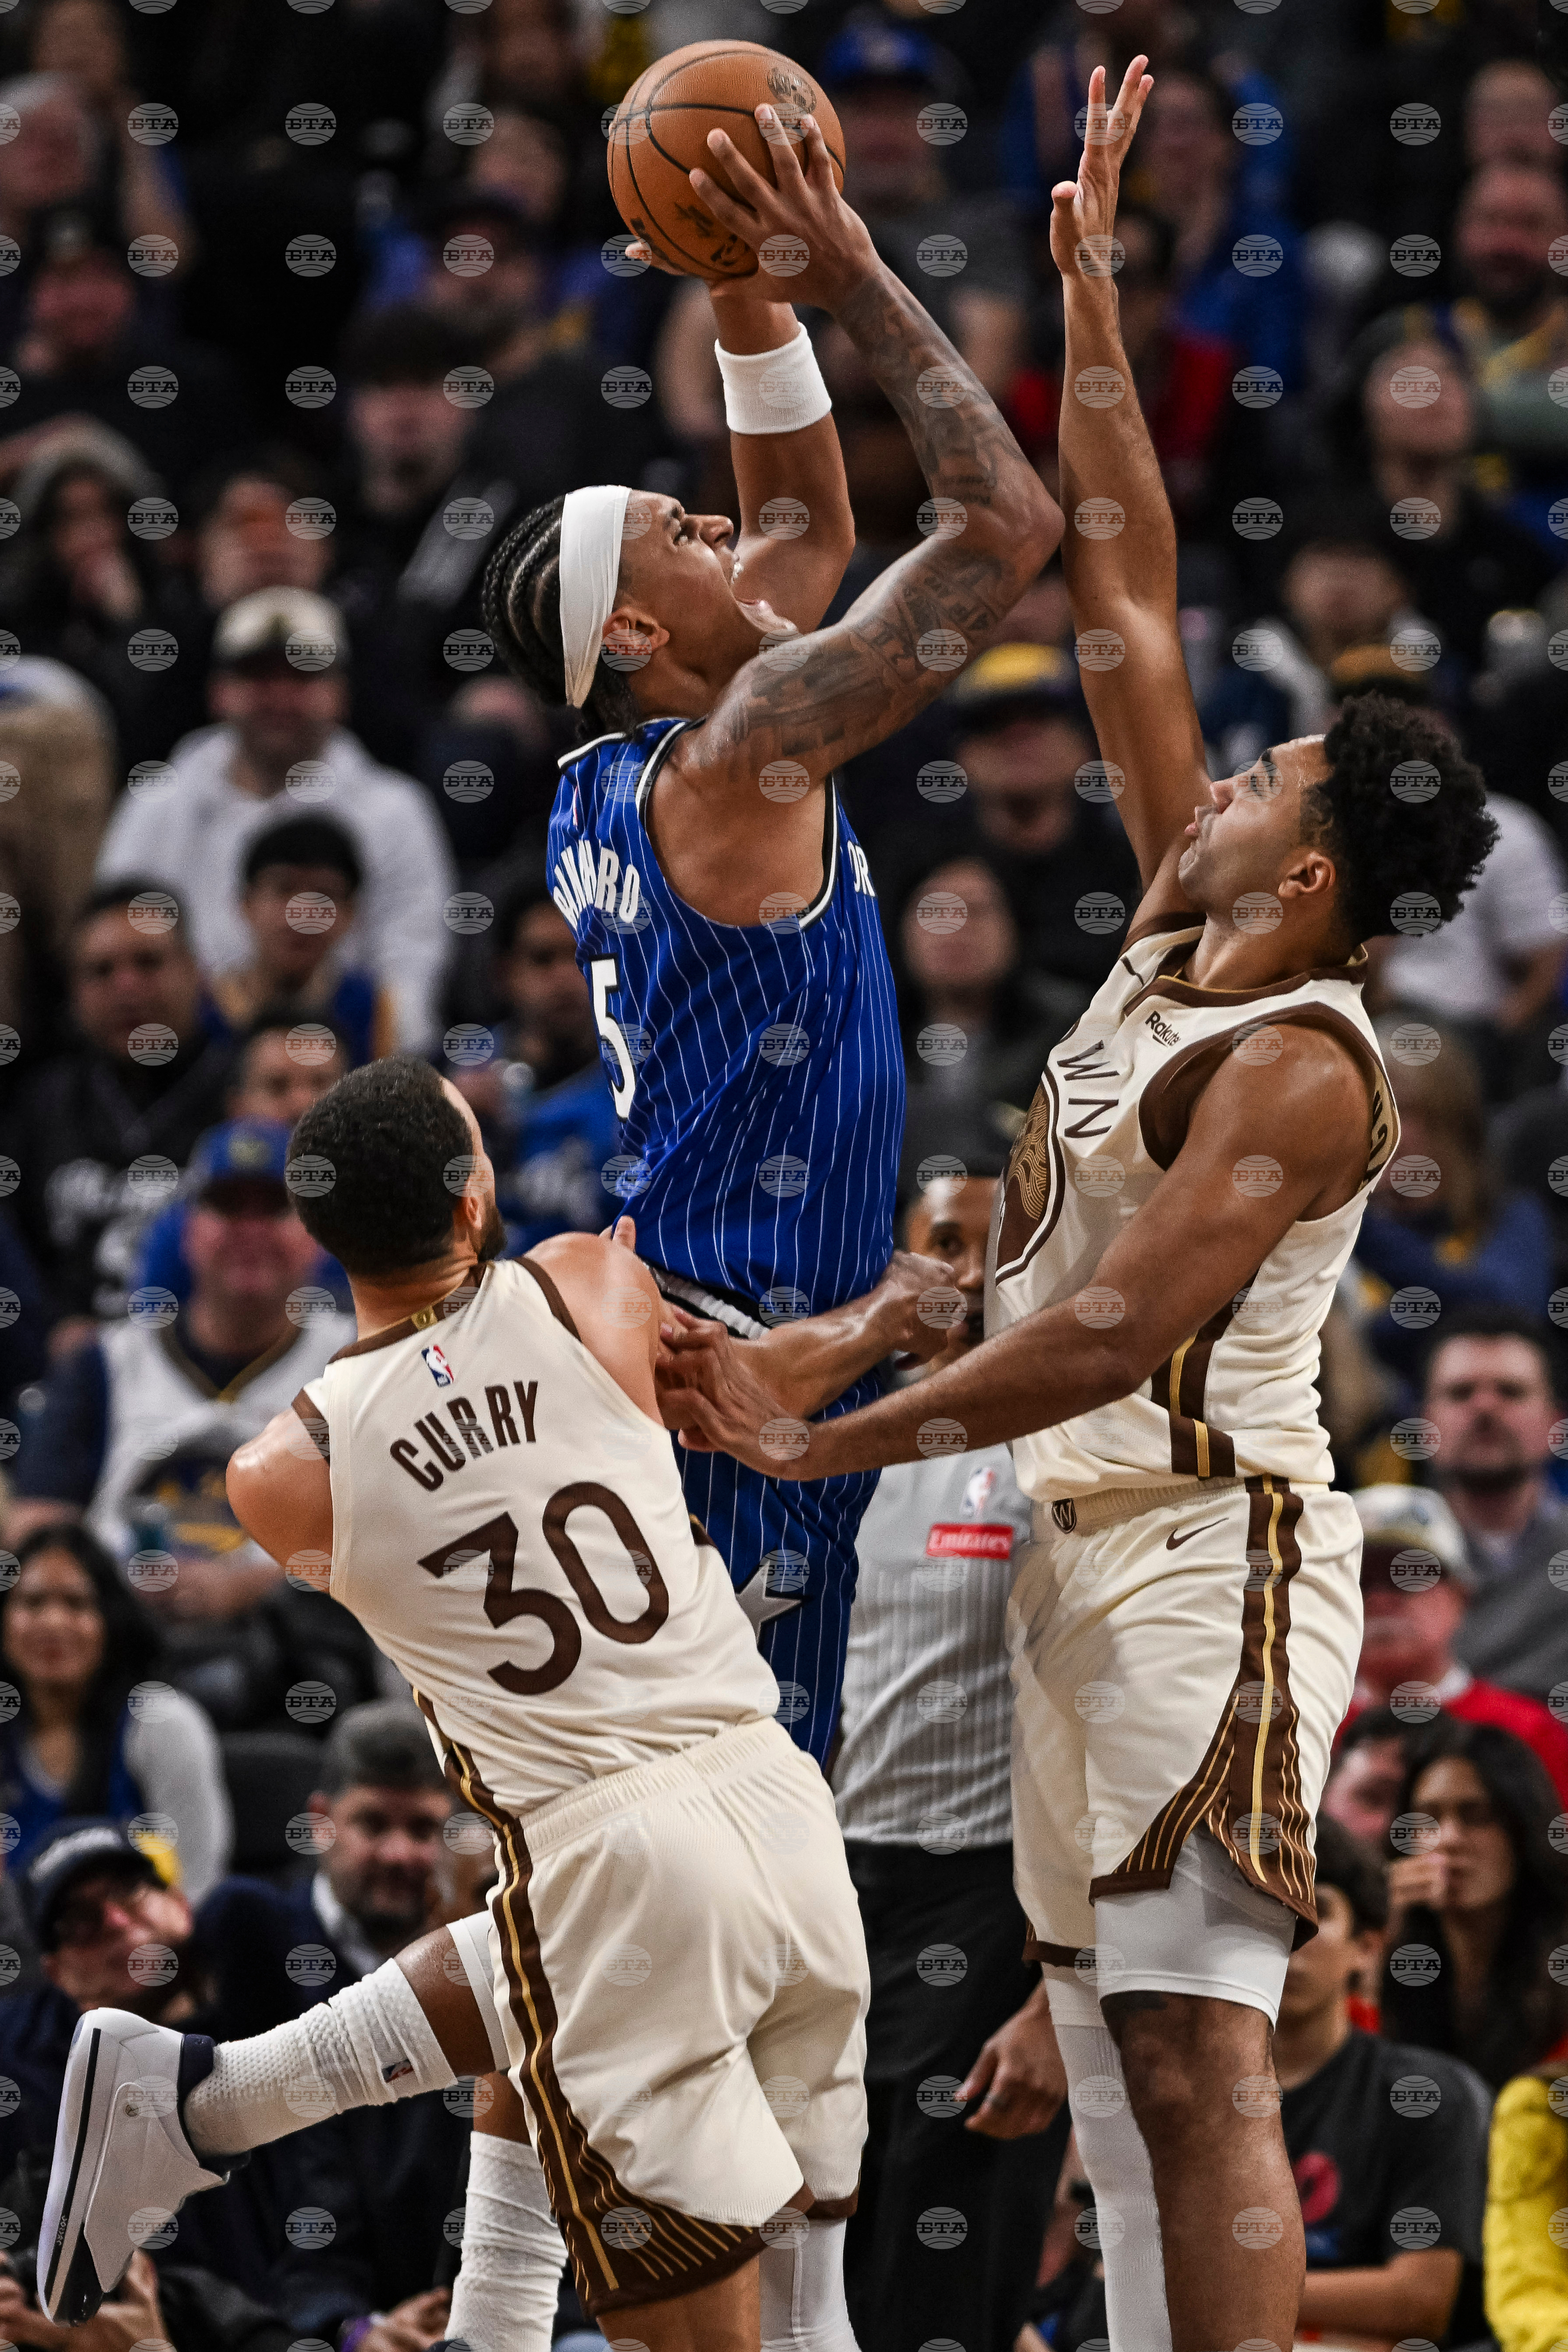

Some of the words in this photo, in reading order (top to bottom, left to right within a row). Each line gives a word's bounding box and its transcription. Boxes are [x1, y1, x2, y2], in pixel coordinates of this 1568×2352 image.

[590, 956, 636, 1120] 5
[389, 1379, 539, 1492] CURRY
[418, 1481, 669, 1696] 30
